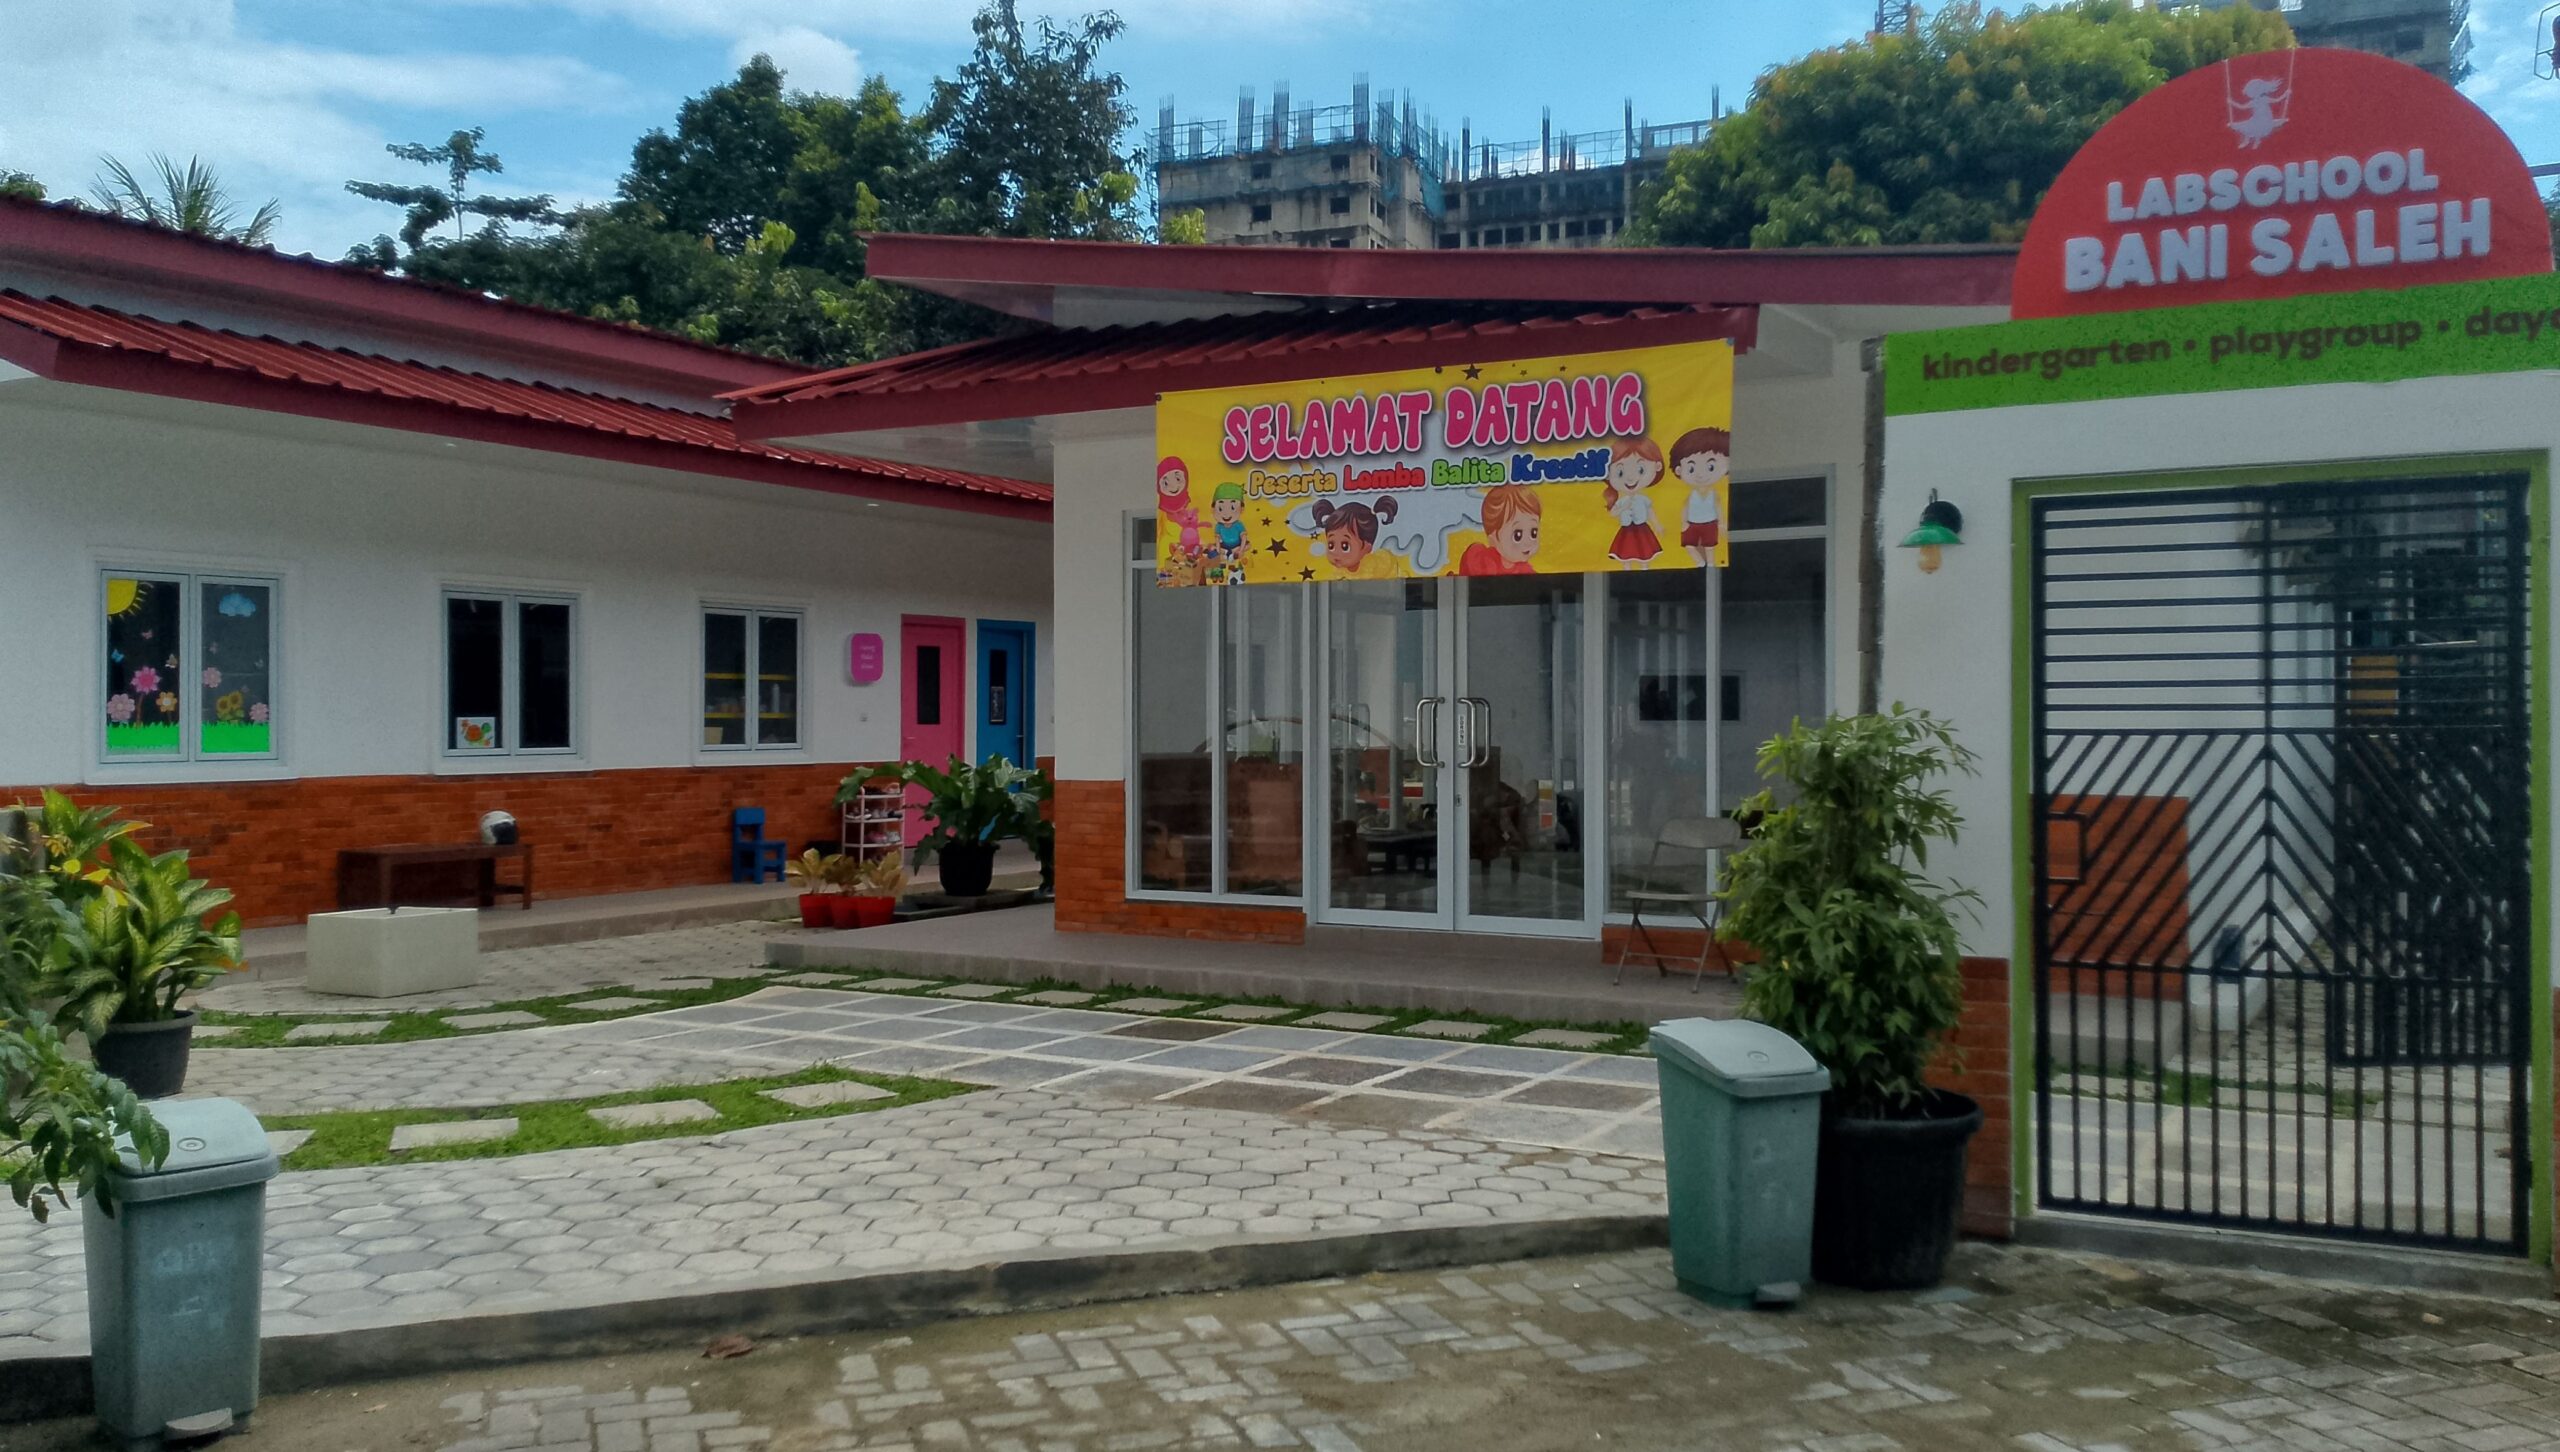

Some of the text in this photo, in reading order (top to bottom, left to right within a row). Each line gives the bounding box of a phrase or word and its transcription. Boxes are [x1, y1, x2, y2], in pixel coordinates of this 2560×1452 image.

[2107, 148, 2439, 223] LABSCHOOL
[2065, 197, 2491, 293] BANI SALEH
[1923, 338, 2172, 381] kindergarten
[2209, 320, 2422, 365] playgroup
[1223, 372, 1645, 464] SELAMAT DATANG
[1249, 447, 1611, 498] Peserta Lomba Balita Kreatif
